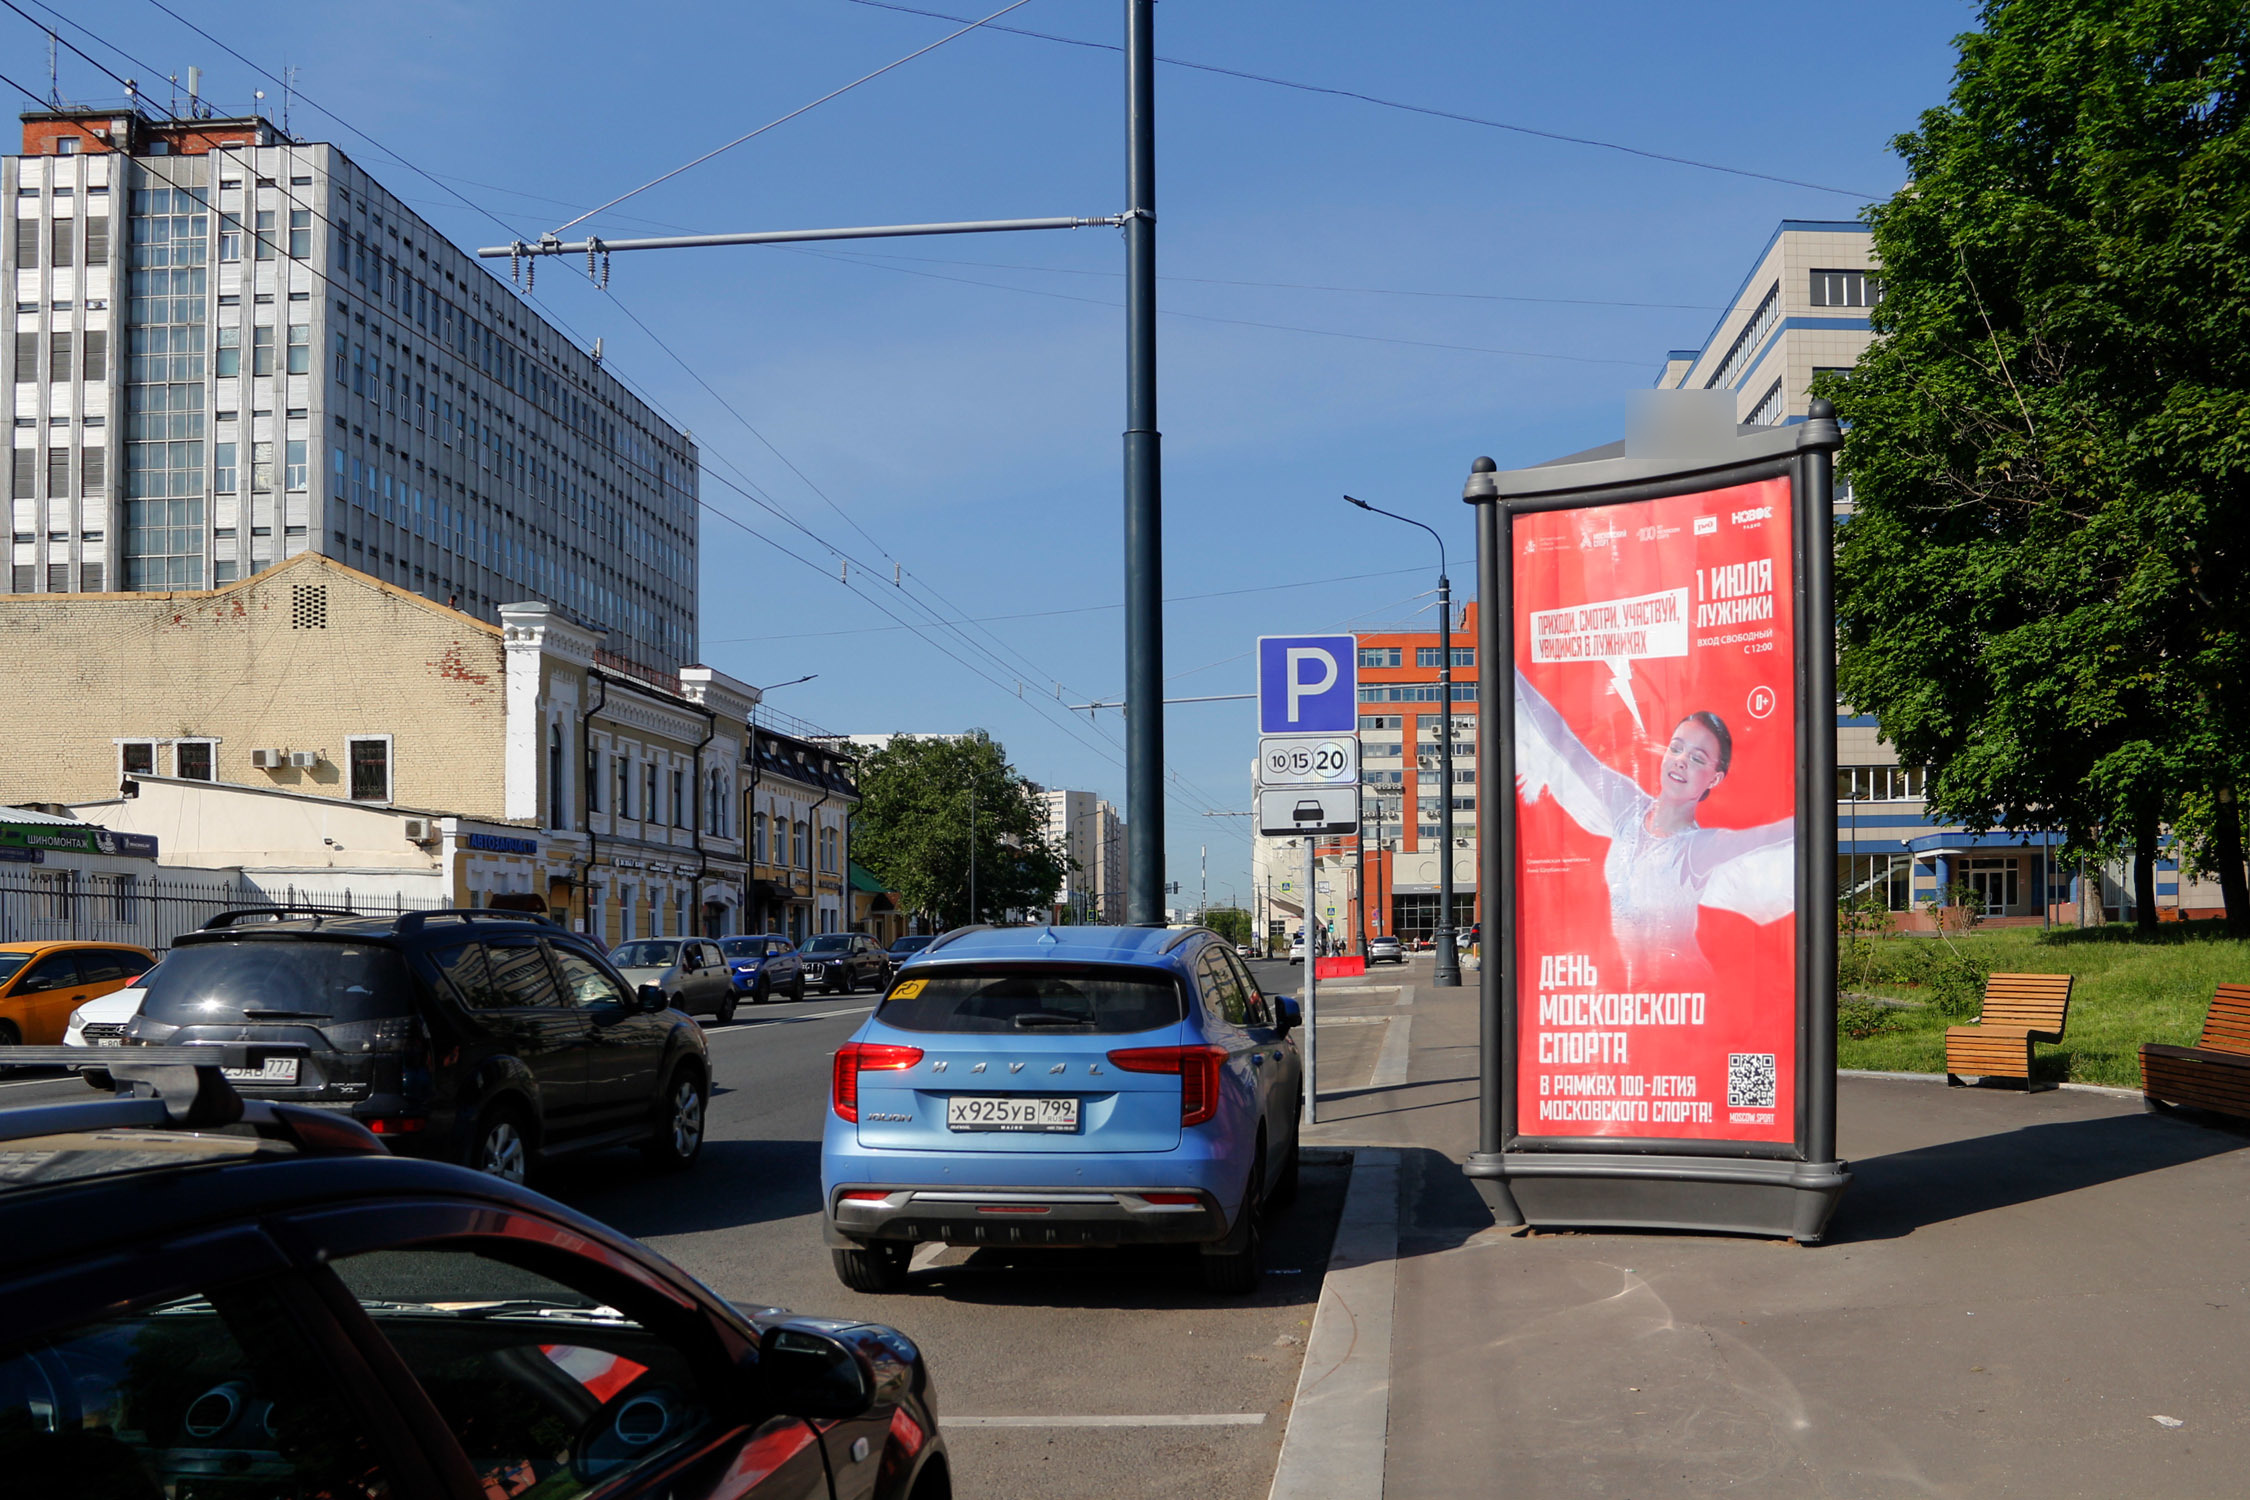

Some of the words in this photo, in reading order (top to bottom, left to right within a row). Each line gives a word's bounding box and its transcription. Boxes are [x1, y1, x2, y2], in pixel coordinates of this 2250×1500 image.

[1696, 569, 1704, 602] 1
[1711, 558, 1773, 600] ИЮЛЯ
[1538, 612, 1578, 636] ПРИХОДИ,
[1579, 606, 1620, 631] СМОТРИ,
[1623, 592, 1680, 627] УЧАСТВУЙ,
[1696, 594, 1773, 629] ЛУЖНИКИ
[1539, 635, 1582, 660] УВИДИМСЯ
[1584, 635, 1591, 656] В
[1593, 630, 1648, 656] ЛУЖНИКАХ
[1697, 636, 1720, 647] ВХОД
[1720, 627, 1773, 644] СВОБОДНЫЙ
[1743, 645, 1750, 654] С
[1752, 642, 1773, 653] 12:00
[1287, 647, 1338, 723] P
[1272, 755, 1286, 768] 10
[1292, 753, 1309, 769] 15
[1316, 751, 1344, 770] 20
[27, 834, 89, 849] ШИНОМОНТАЖ
[1539, 955, 1598, 990] ДЕНЬ
[1539, 992, 1705, 1025] МОСКОВСКОГО
[1539, 1032, 1627, 1064] СПОРТА
[268, 1060, 293, 1073] 777
[932, 1061, 1104, 1076] HAVAL
[1539, 1075, 1549, 1095] В
[1554, 1075, 1616, 1096] РАМКАХ
[1620, 1075, 1696, 1097] 100-ЛЕТИЯ
[866, 1112, 913, 1123] JOLION
[1041, 1100, 1072, 1116] 799
[1539, 1100, 1648, 1122] МОСКОВСКОГО
[1652, 1102, 1713, 1123] СПОРТА!
